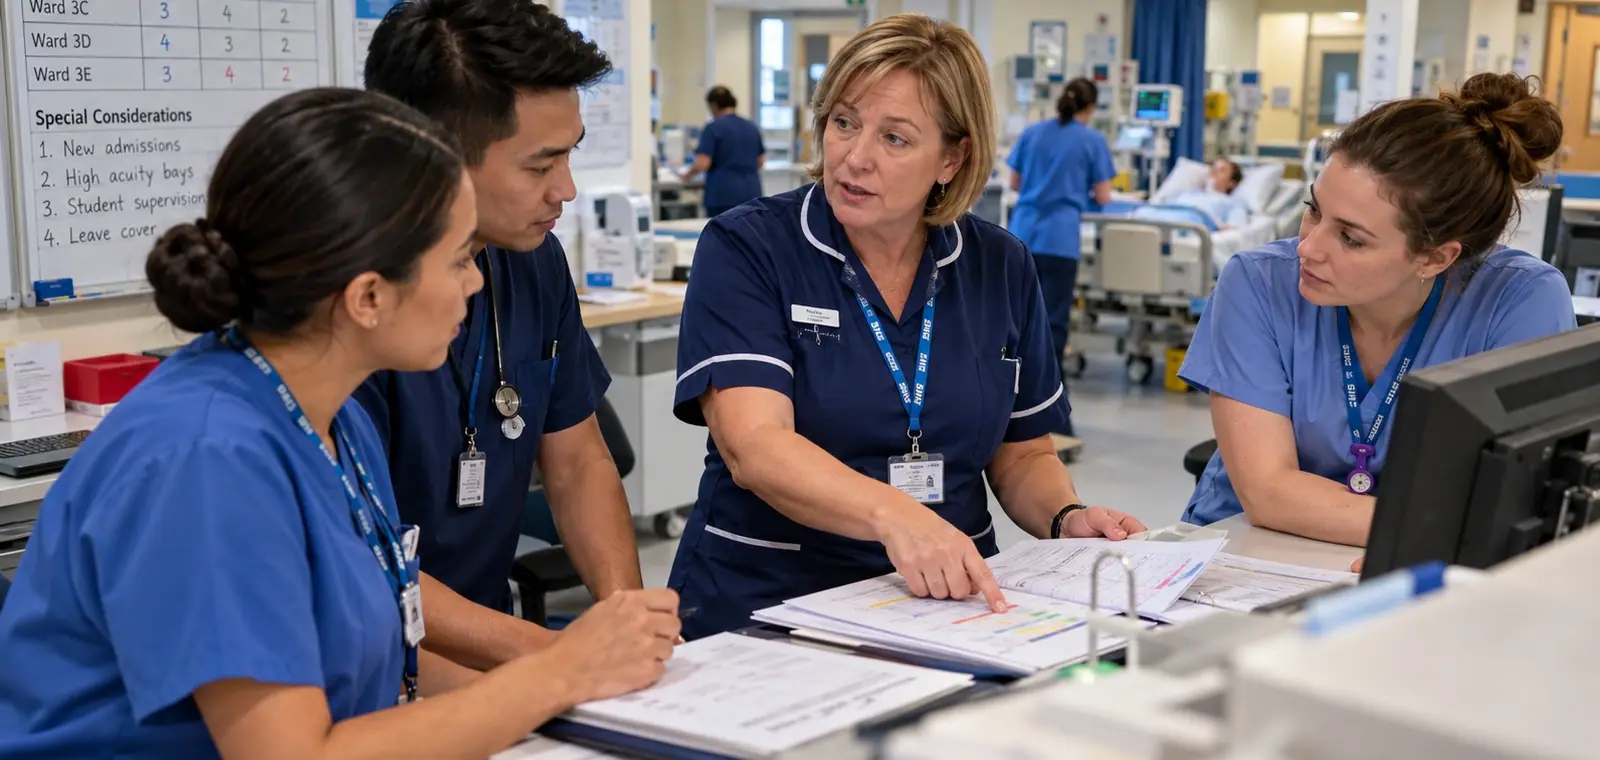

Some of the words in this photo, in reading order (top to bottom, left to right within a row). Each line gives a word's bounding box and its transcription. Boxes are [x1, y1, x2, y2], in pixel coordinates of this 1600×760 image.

[29, 0, 66, 14] Ward
[72, 0, 89, 15] 3C
[159, 1, 170, 20] 3
[222, 4, 232, 23] 4
[280, 8, 290, 24] 2
[31, 32, 67, 48] Ward
[73, 34, 91, 48] 3D
[159, 33, 171, 52] 4
[225, 35, 234, 53] 3
[281, 37, 291, 53] 2
[34, 66, 69, 81] Ward
[76, 67, 92, 81] 3E
[162, 65, 172, 83] 3
[225, 65, 235, 83] 4
[282, 66, 291, 82] 2
[36, 109, 87, 129] Special
[93, 108, 192, 124] Considerations
[40, 141, 52, 158] 1.
[64, 140, 94, 157] New
[106, 138, 181, 154] admissions
[41, 171, 55, 187] 2.
[66, 168, 100, 192] High
[110, 165, 153, 187] acuity
[163, 163, 193, 185] bays
[43, 200, 57, 217] 3.
[68, 196, 124, 215] Student
[134, 191, 206, 211] supervision
[44, 229, 59, 247] 4.
[70, 227, 111, 244] Leave
[121, 225, 158, 239] cover
